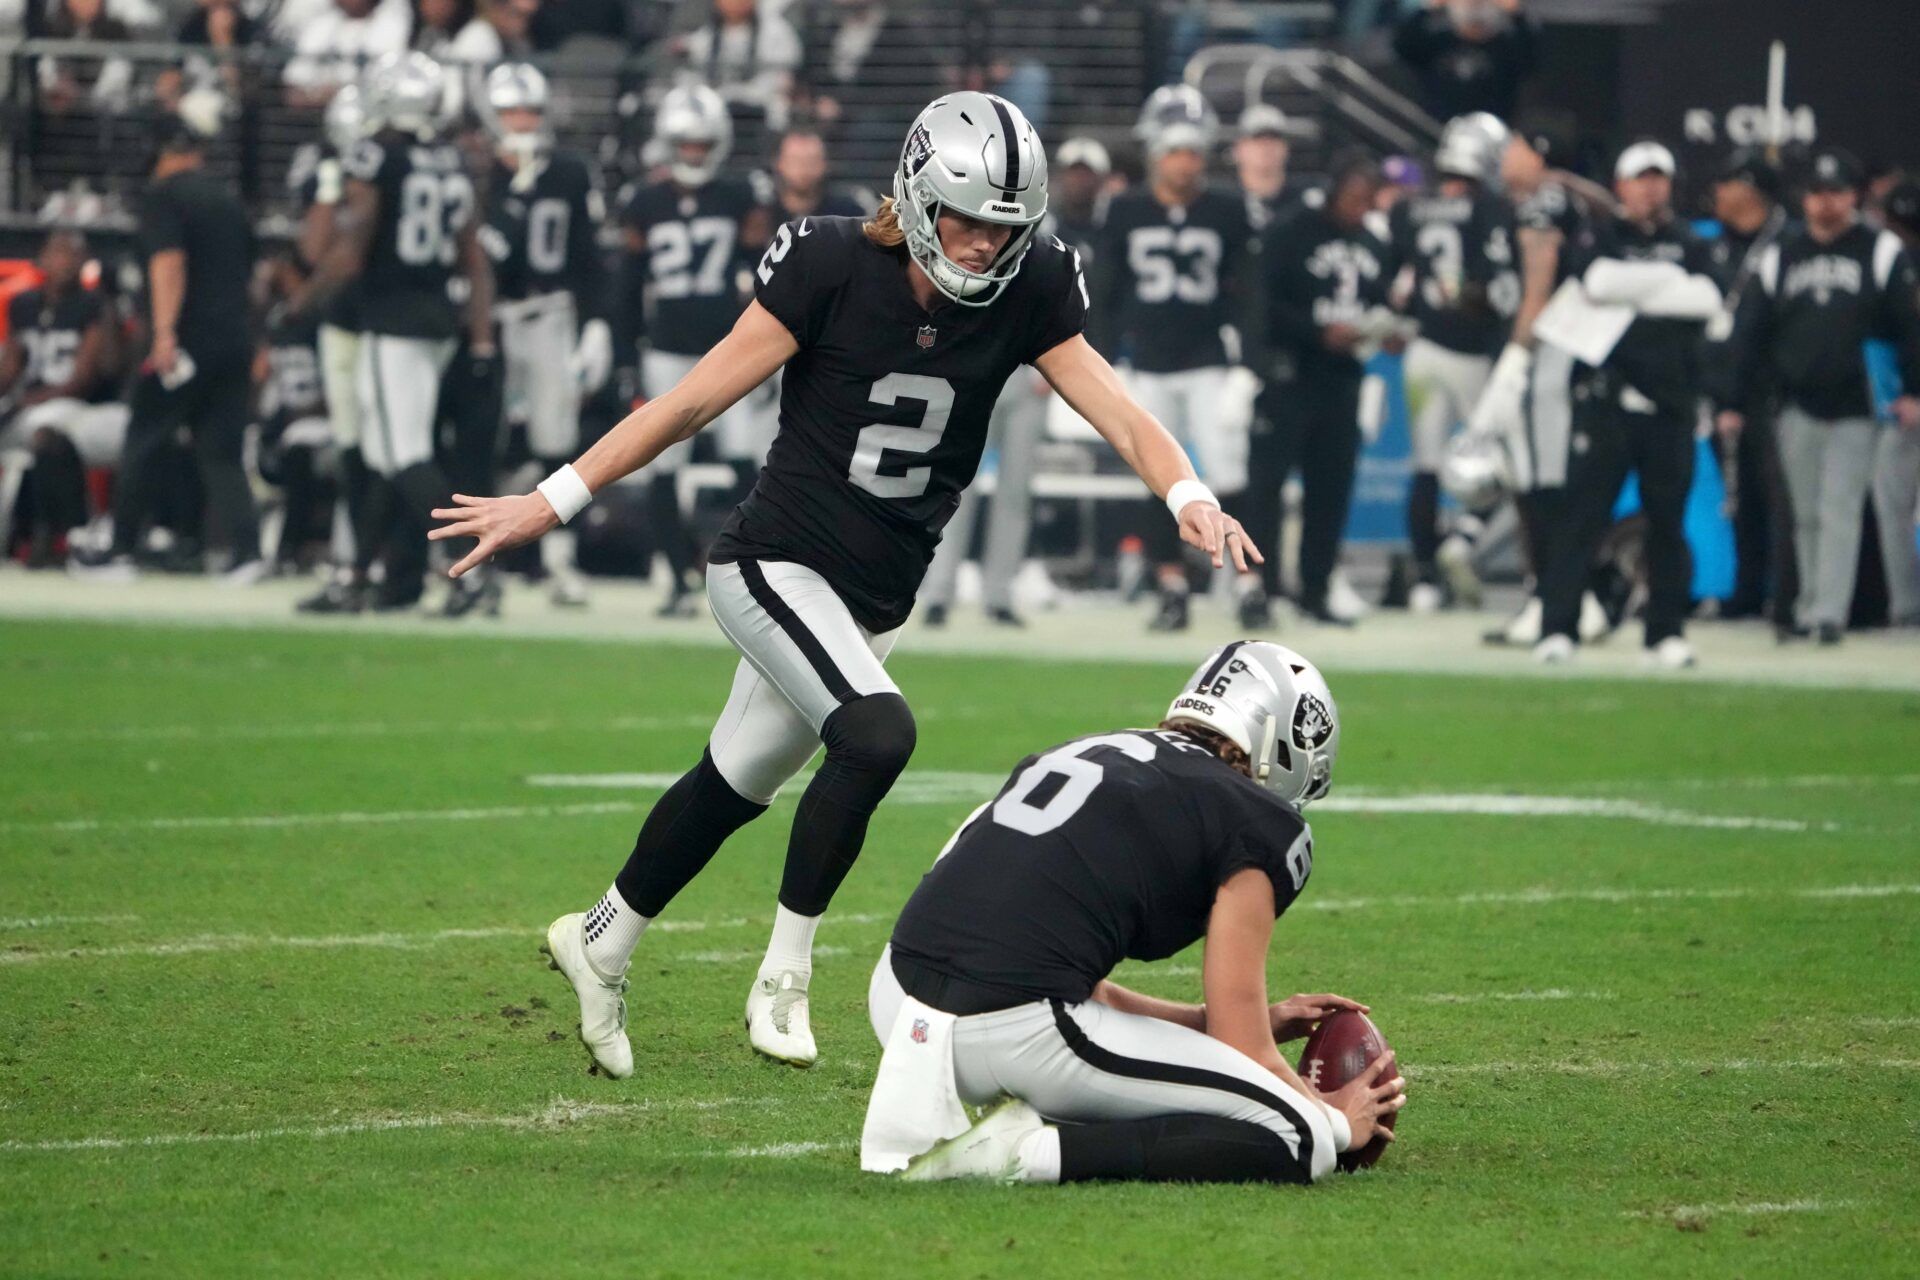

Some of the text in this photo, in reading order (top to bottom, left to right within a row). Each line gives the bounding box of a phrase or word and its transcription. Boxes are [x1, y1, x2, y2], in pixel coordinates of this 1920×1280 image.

[991, 204, 1021, 215] RAIDERS
[648, 217, 738, 298] 27
[757, 222, 792, 286] 2
[1127, 226, 1221, 303] 53
[848, 371, 955, 499] 2
[1211, 676, 1232, 698] 6
[993, 733, 1157, 836] 6
